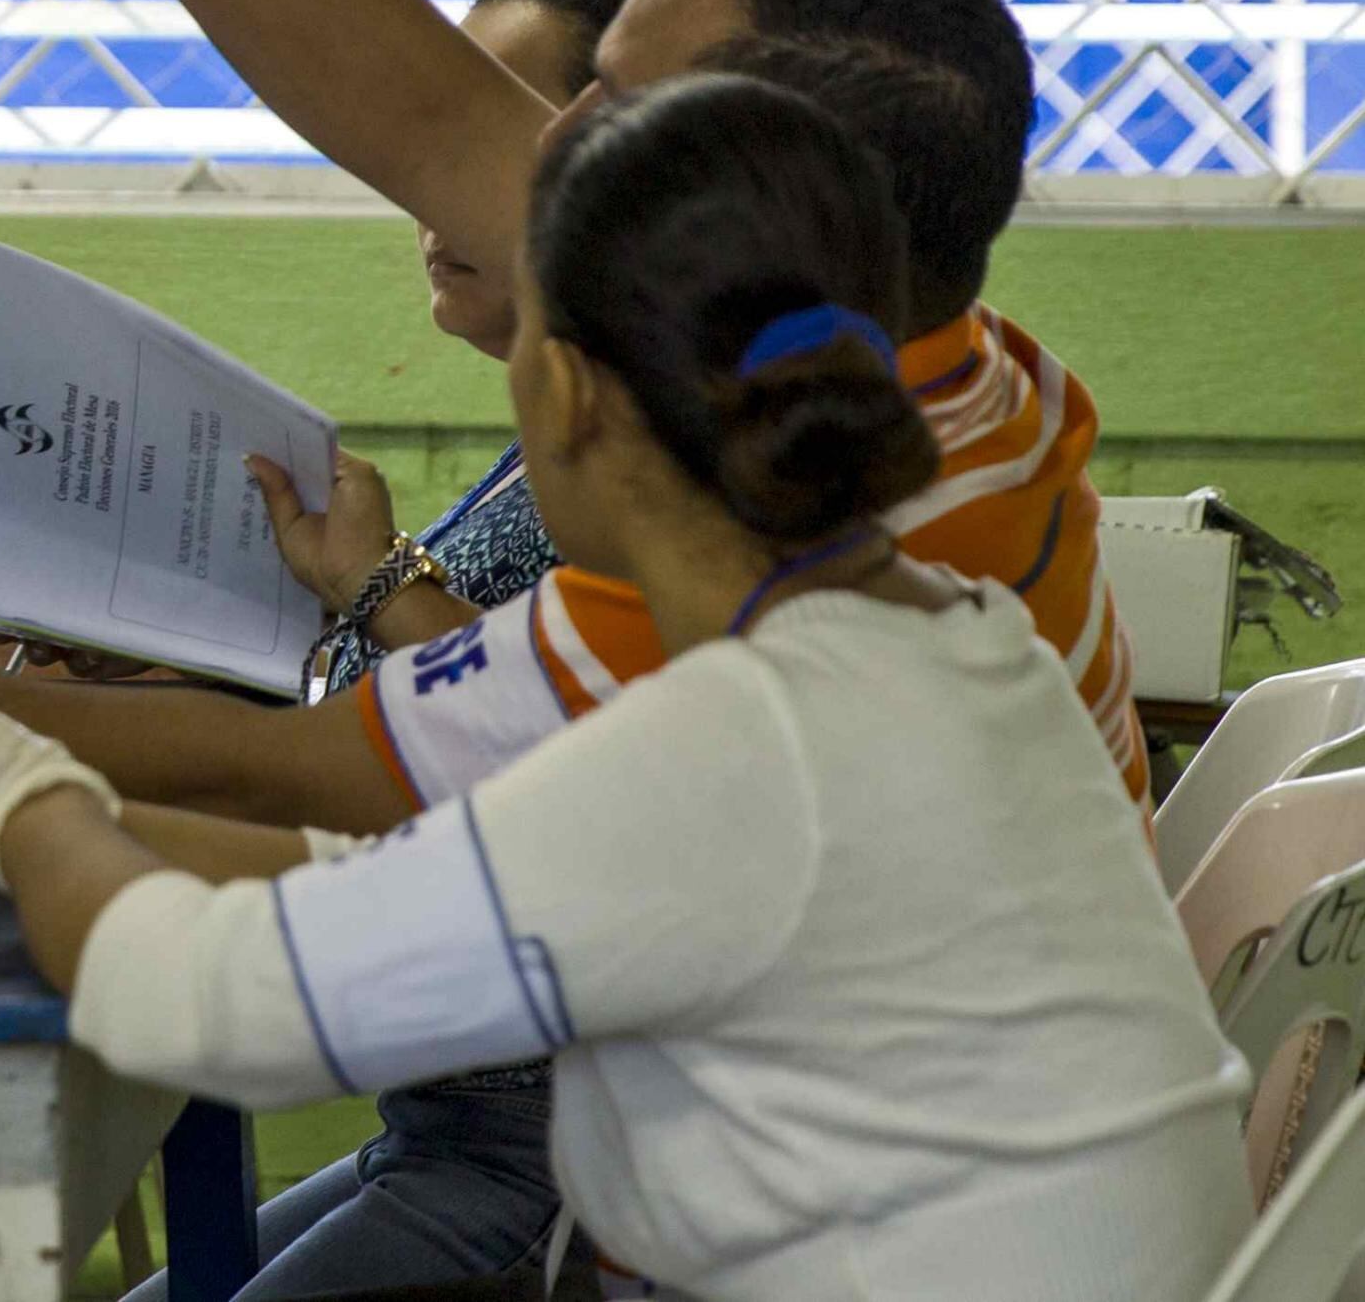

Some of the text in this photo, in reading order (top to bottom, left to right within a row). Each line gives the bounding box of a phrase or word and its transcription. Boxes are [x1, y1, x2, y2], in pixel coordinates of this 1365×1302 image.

[60, 382, 79, 424] Electoral
[83, 394, 99, 418] Mesa
[78, 430, 94, 472] Electoral
[100, 421, 118, 466] Generales
[53, 465, 73, 501] Consejo
[137, 444, 157, 492] MANAGUA
[95, 467, 112, 512] Elecciones
